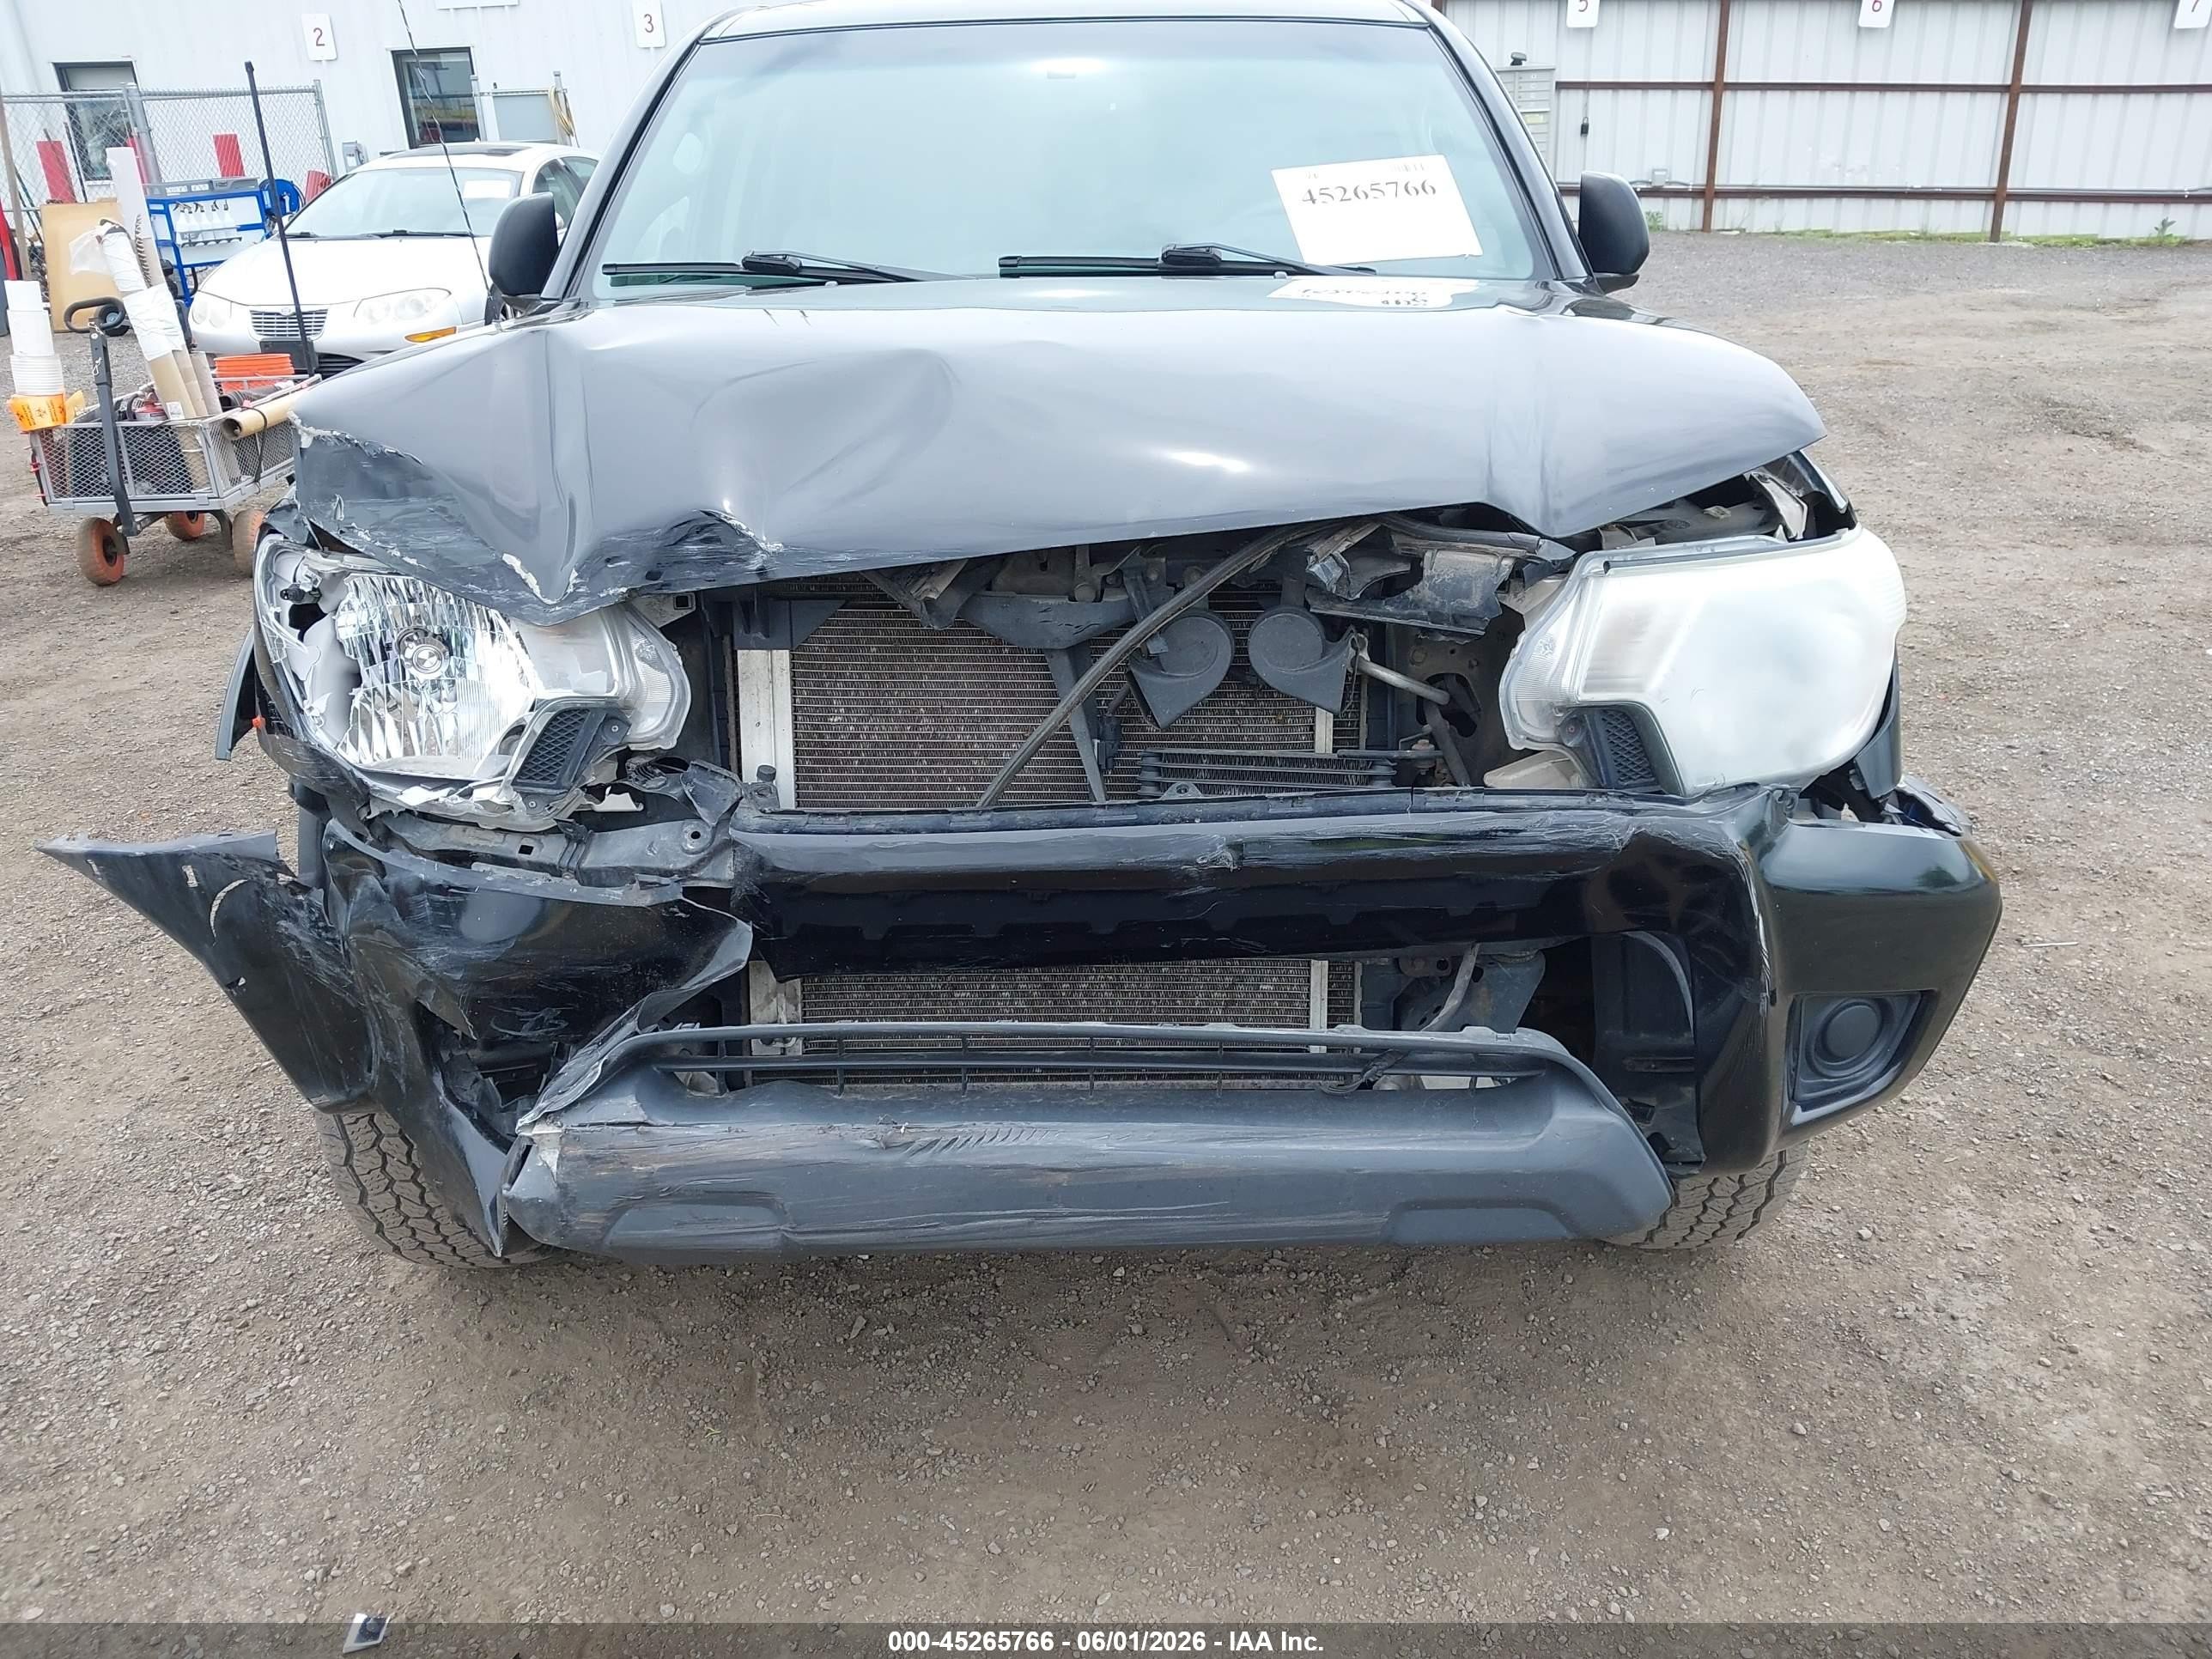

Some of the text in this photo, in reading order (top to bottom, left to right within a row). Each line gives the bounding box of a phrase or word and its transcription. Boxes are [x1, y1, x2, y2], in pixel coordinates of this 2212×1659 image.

[1871, 0, 1882, 13] 6
[643, 13, 654, 33] 3
[313, 27, 325, 47] 2
[1302, 179, 1437, 205] 45265766
